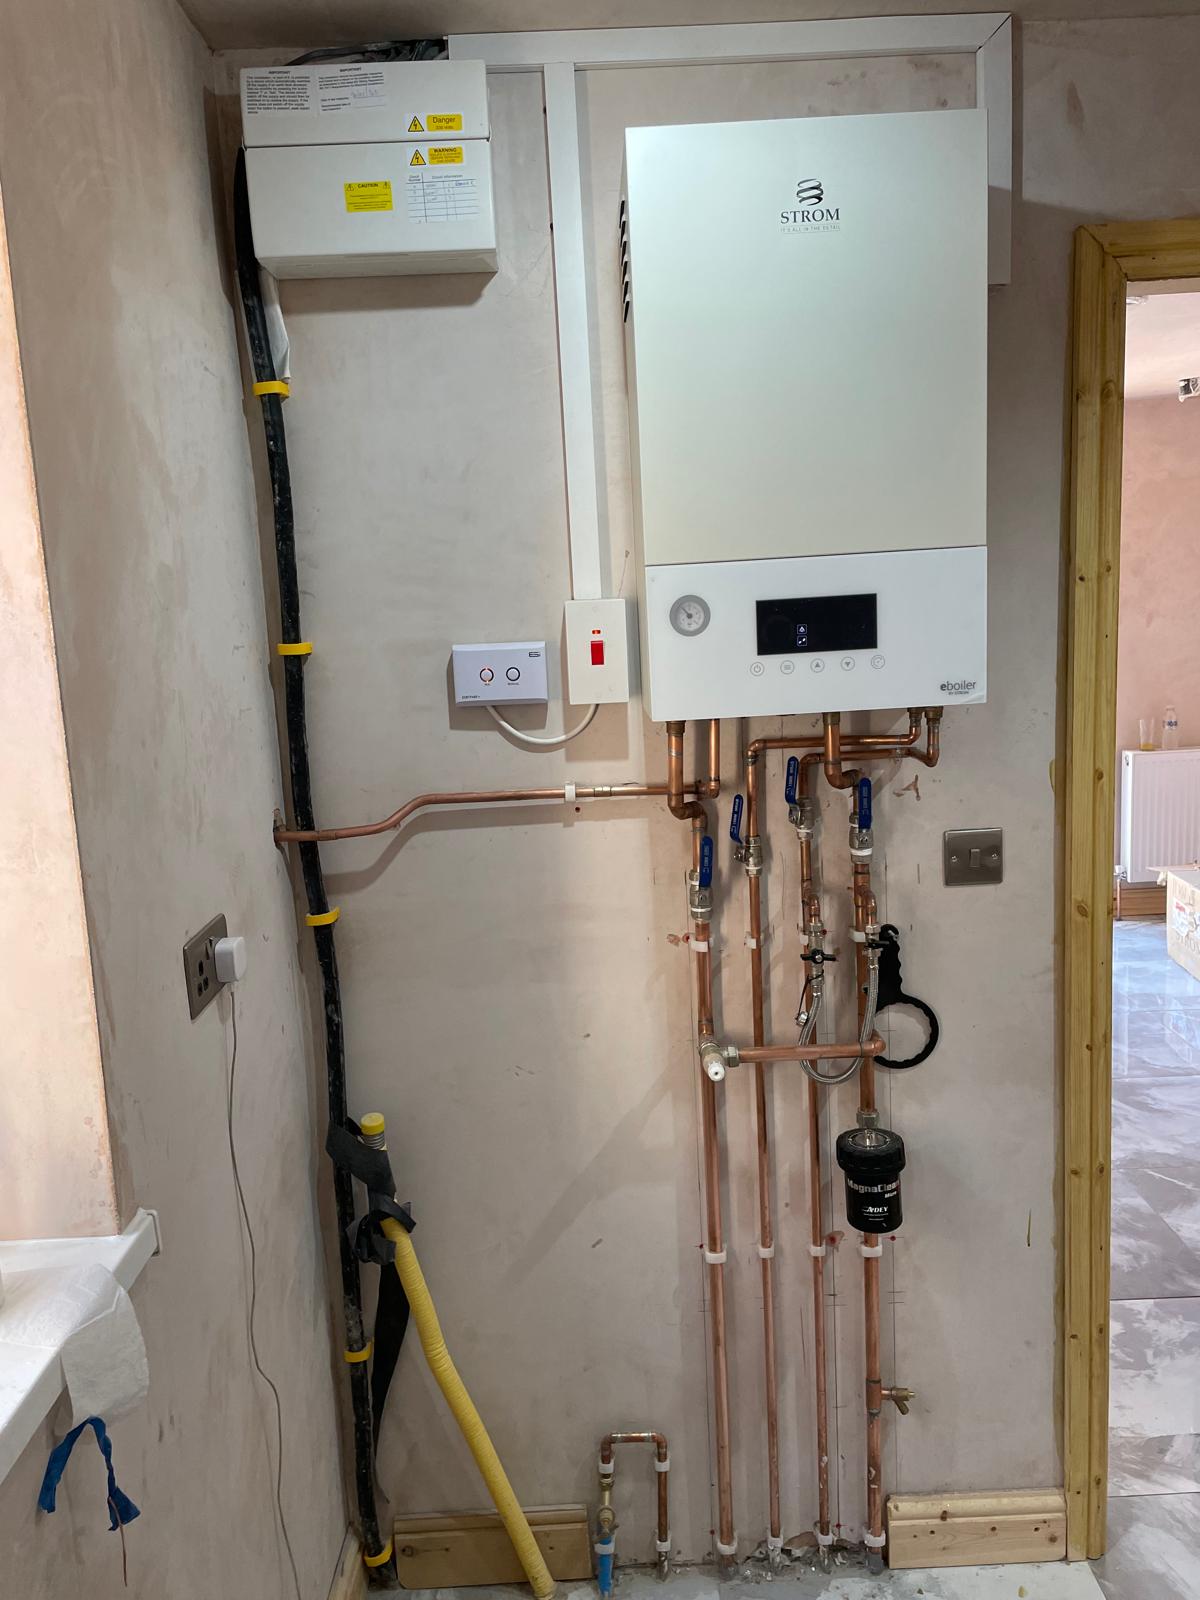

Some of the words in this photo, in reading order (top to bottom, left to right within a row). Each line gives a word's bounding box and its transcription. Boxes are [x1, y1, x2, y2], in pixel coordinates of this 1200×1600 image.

[432, 116, 456, 125] Danger
[780, 208, 841, 224] STROM
[940, 680, 977, 691] eboiler
